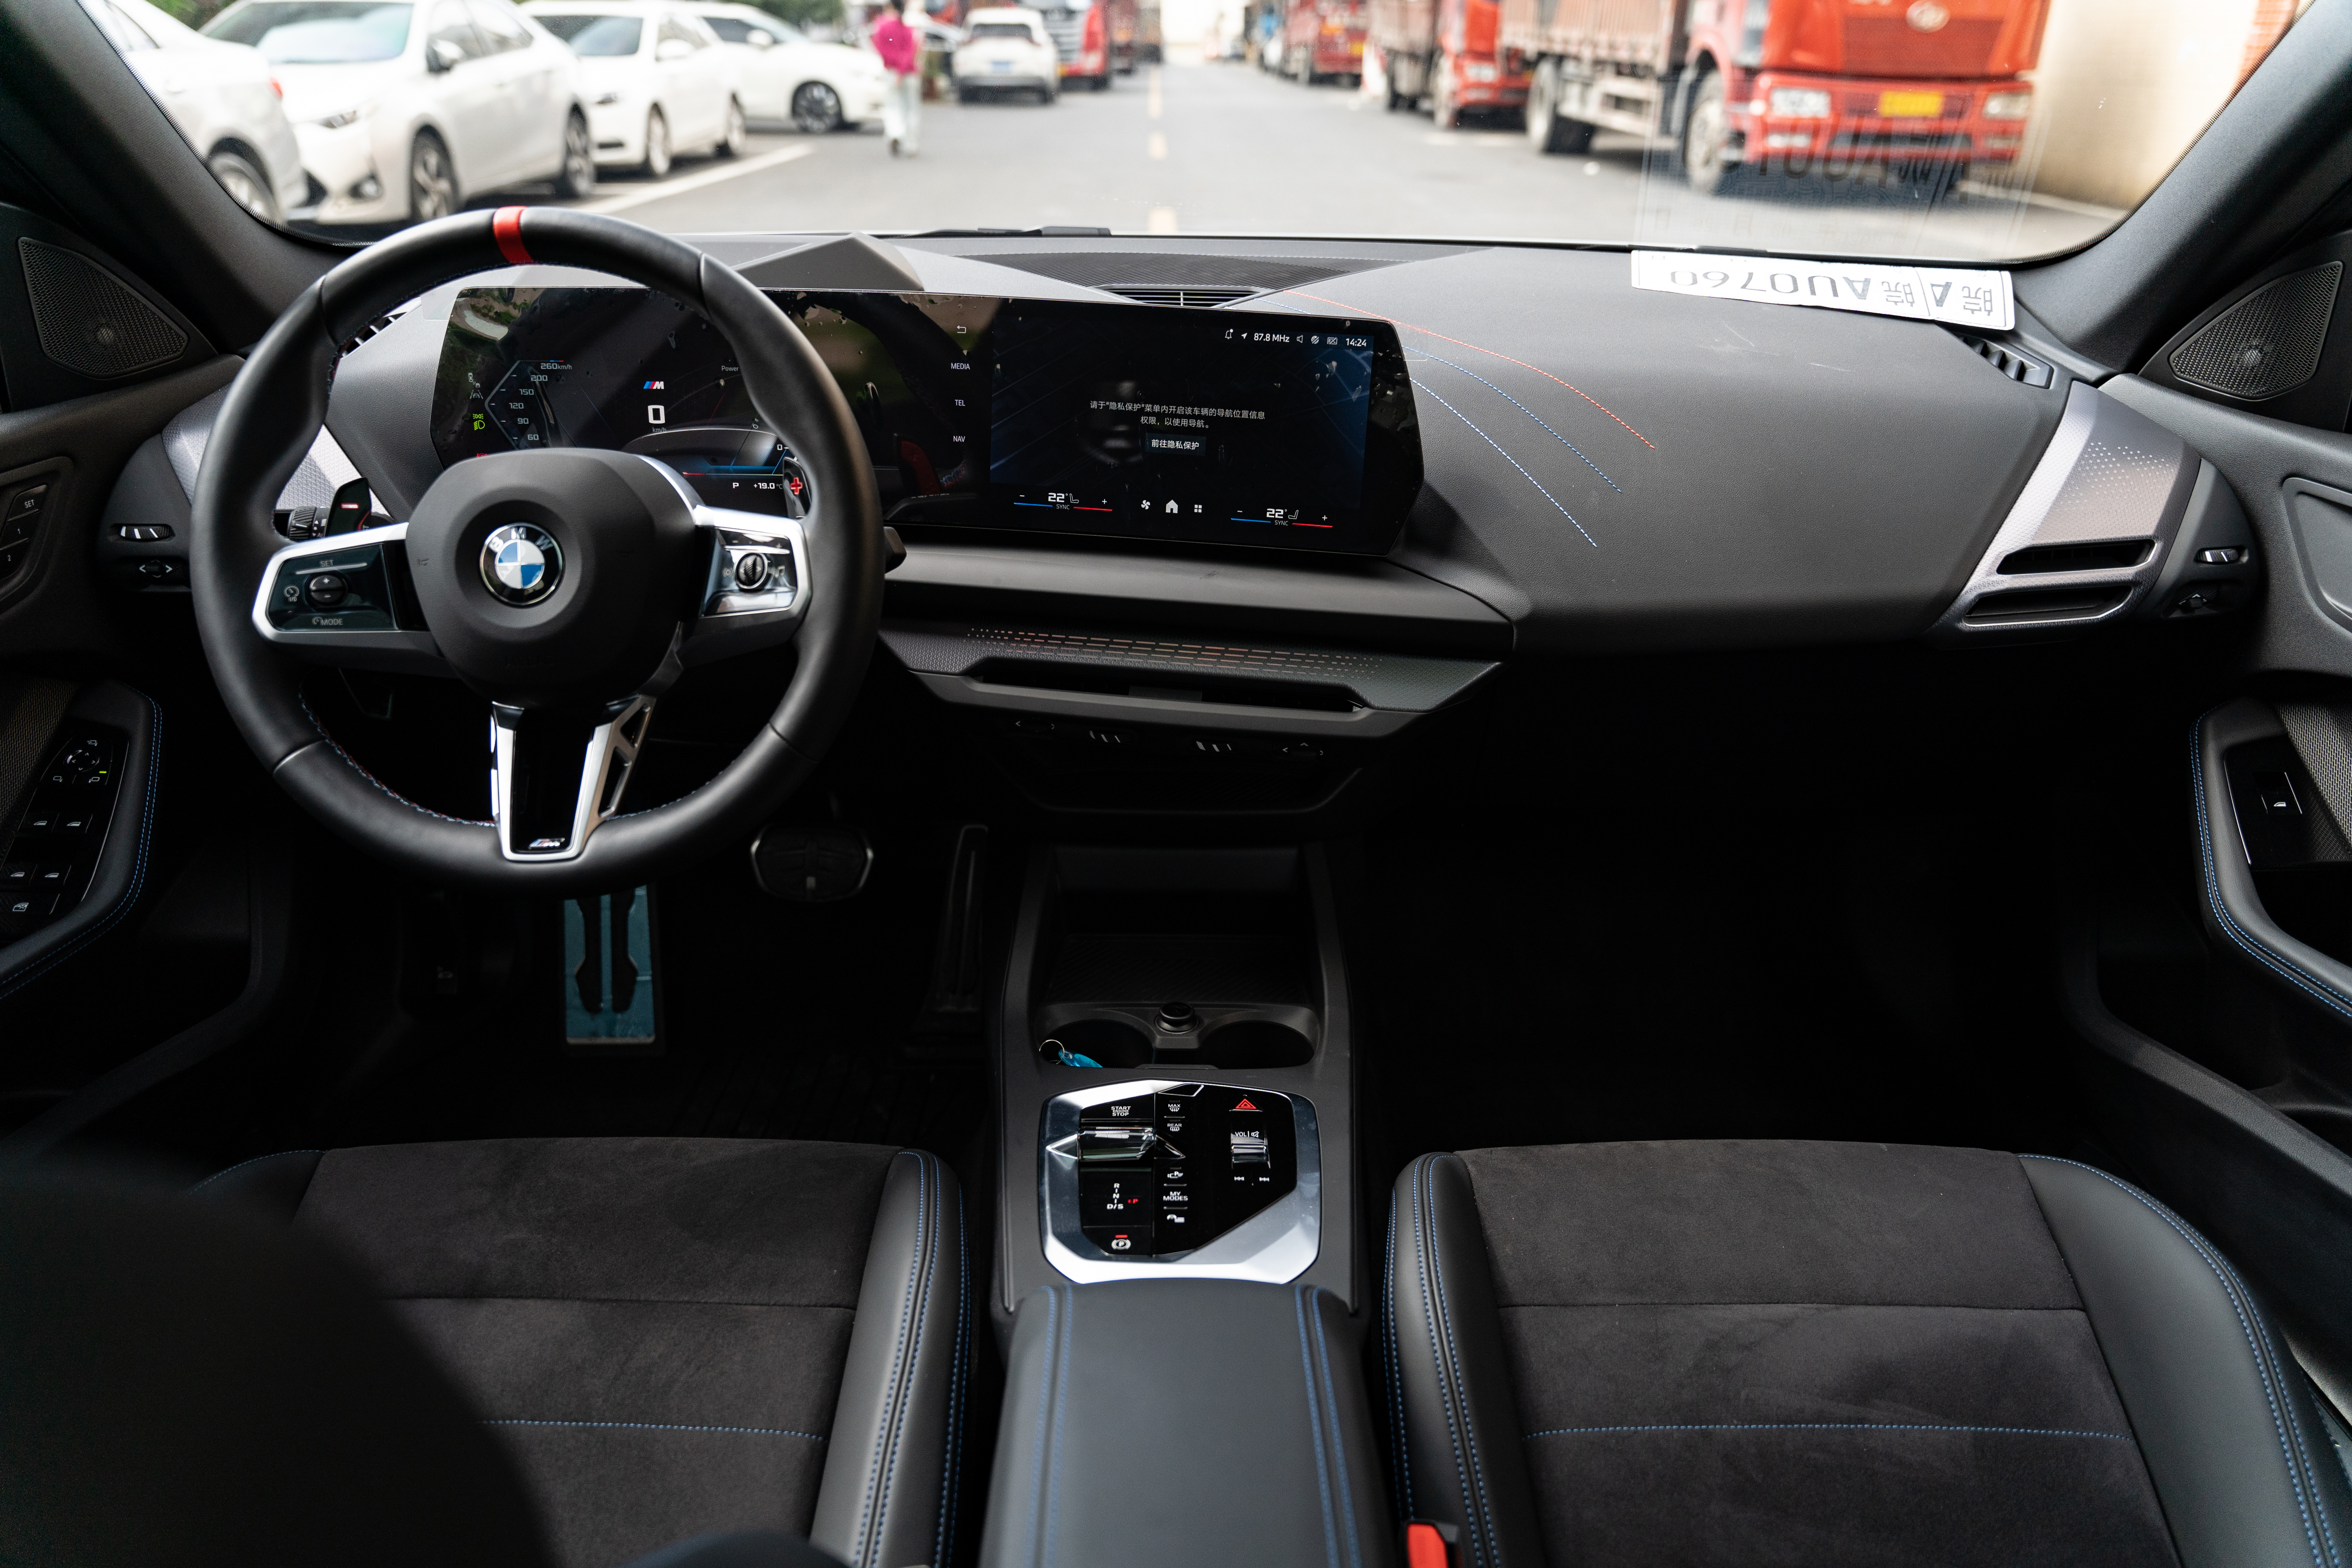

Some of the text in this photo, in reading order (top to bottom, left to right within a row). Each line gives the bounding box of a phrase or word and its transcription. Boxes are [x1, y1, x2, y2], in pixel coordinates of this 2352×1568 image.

[1253, 333, 1290, 343] 87.8 MHz
[1346, 338, 1366, 347] 14:24
[648, 404, 666, 424] 0
[1151, 439, 1200, 450] 前往隐私保护
[24, 500, 34, 508] SET
[488, 526, 553, 553] BMW
